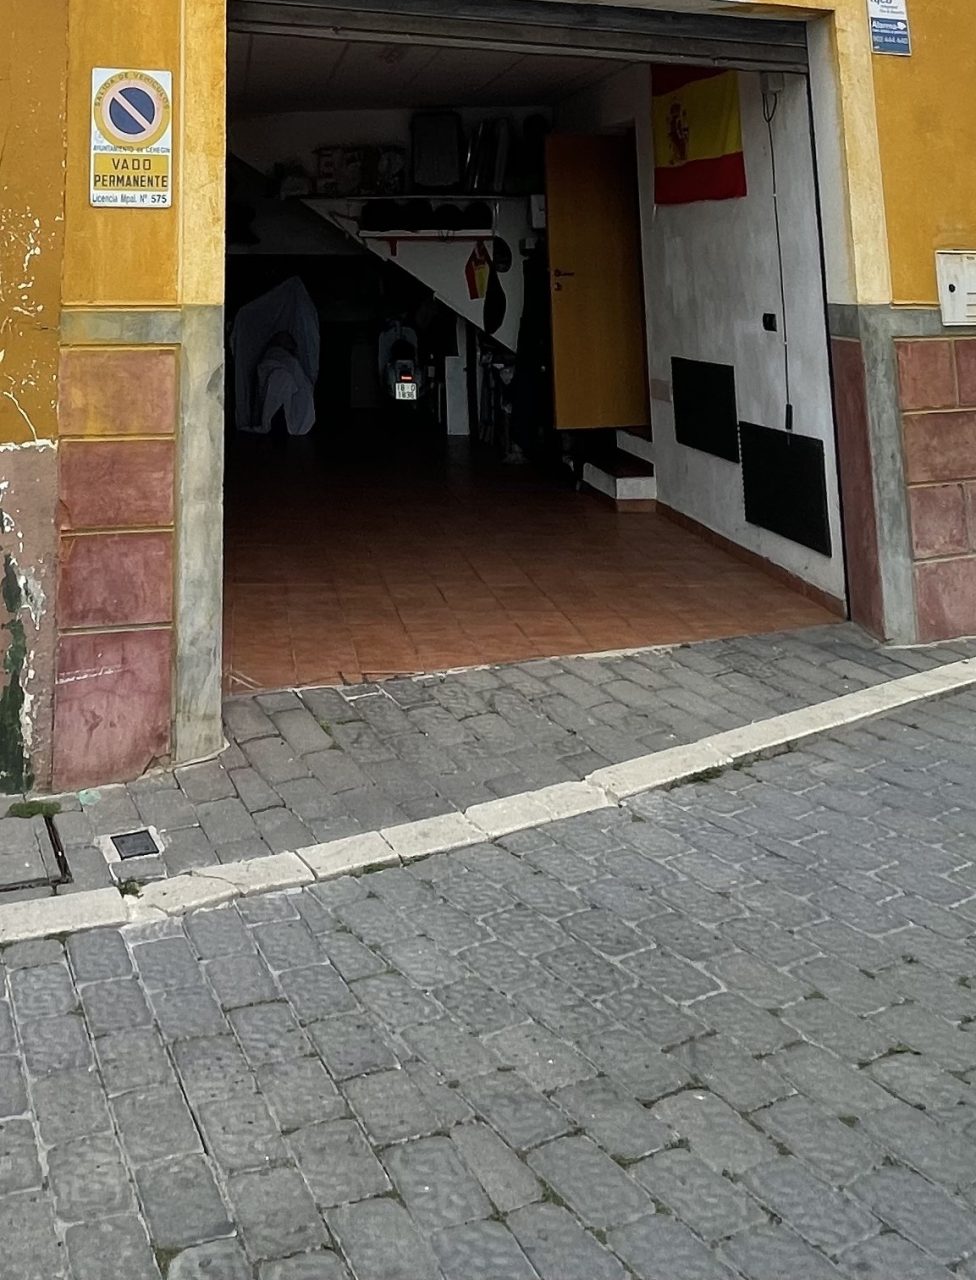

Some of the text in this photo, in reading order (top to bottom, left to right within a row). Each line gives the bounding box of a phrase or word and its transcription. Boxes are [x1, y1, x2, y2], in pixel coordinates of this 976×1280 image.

[94, 71, 170, 109] SALIDA DE VEHICULOS
[112, 158, 152, 171] VADO
[94, 174, 168, 188] PERMANENTE
[92, 193, 118, 203] Licencia
[151, 194, 167, 204] 575
